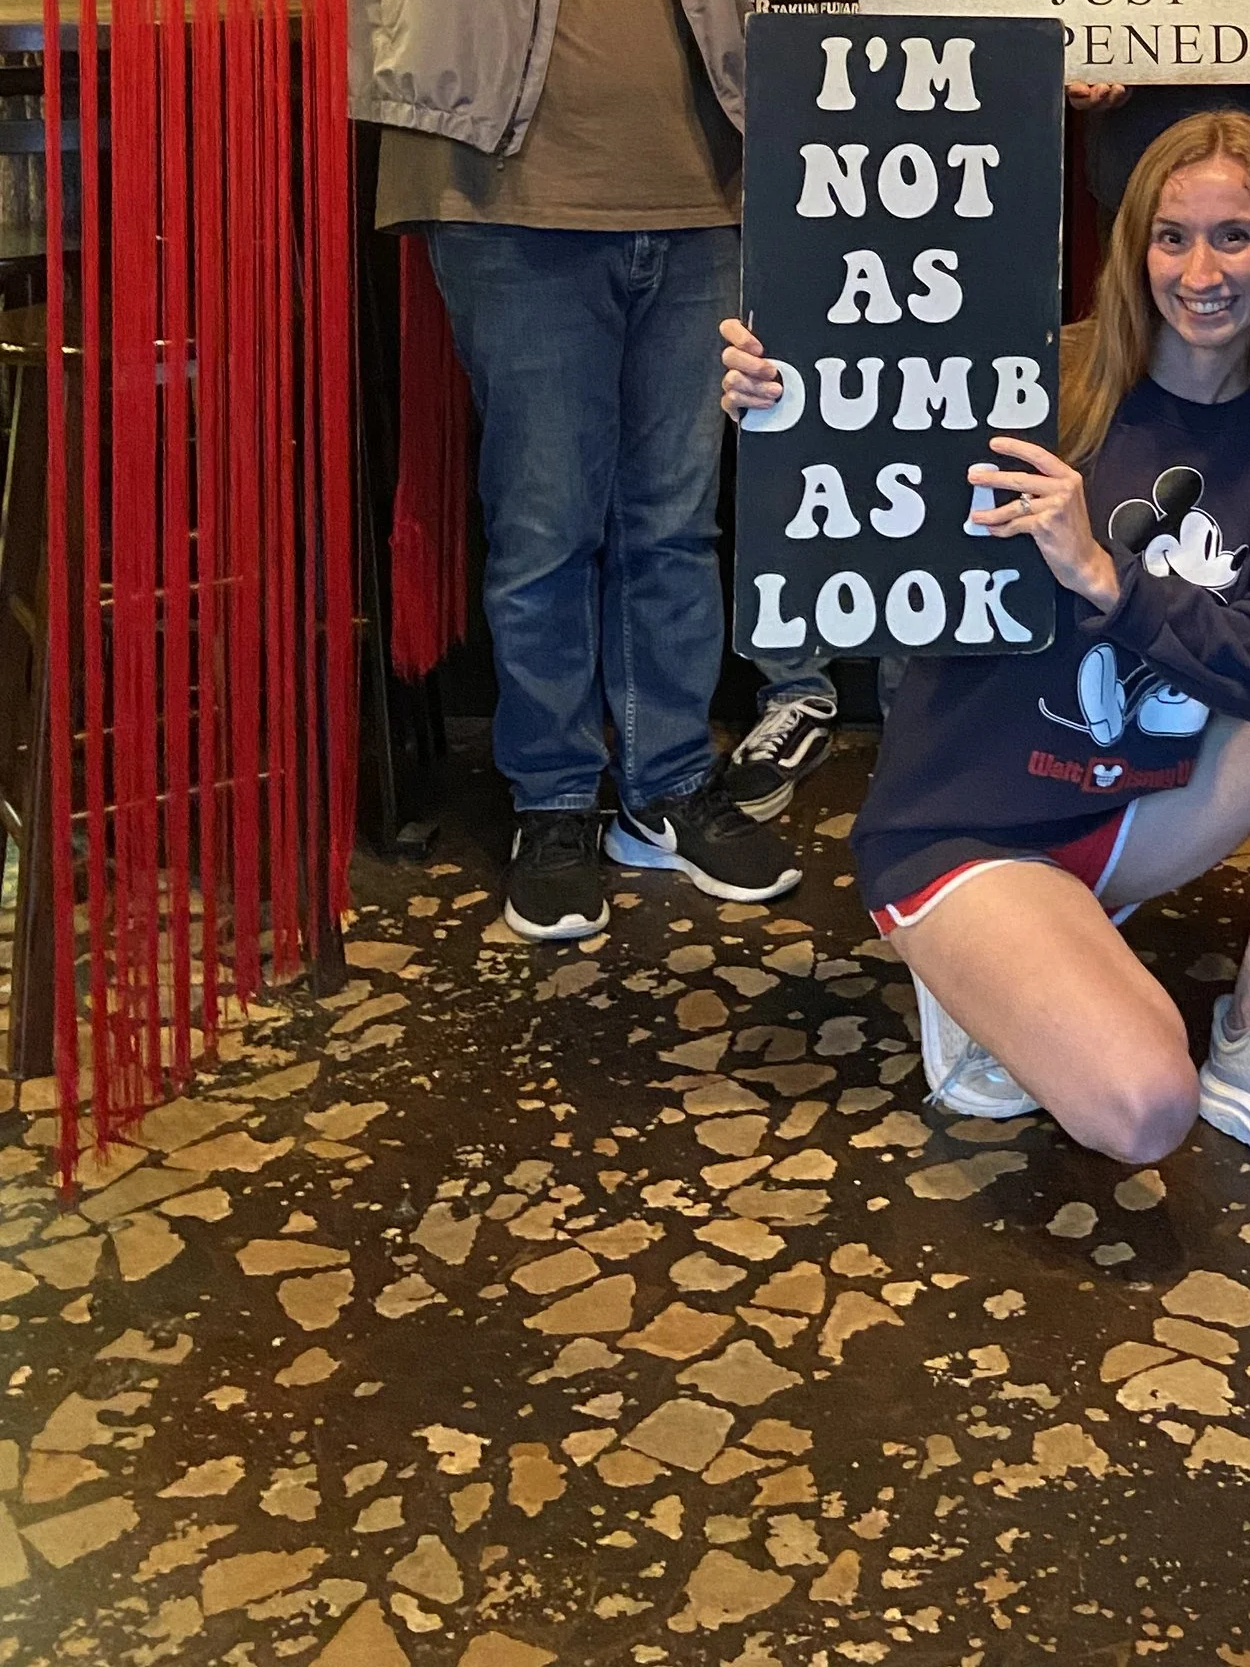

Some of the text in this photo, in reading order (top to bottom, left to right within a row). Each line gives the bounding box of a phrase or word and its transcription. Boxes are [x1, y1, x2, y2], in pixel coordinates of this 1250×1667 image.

[815, 35, 982, 113] I'M
[794, 142, 1001, 220] NOT
[826, 247, 964, 325] AS
[740, 355, 1051, 433] DUMB
[783, 461, 1002, 540] AS I
[750, 568, 1034, 650] LOOK
